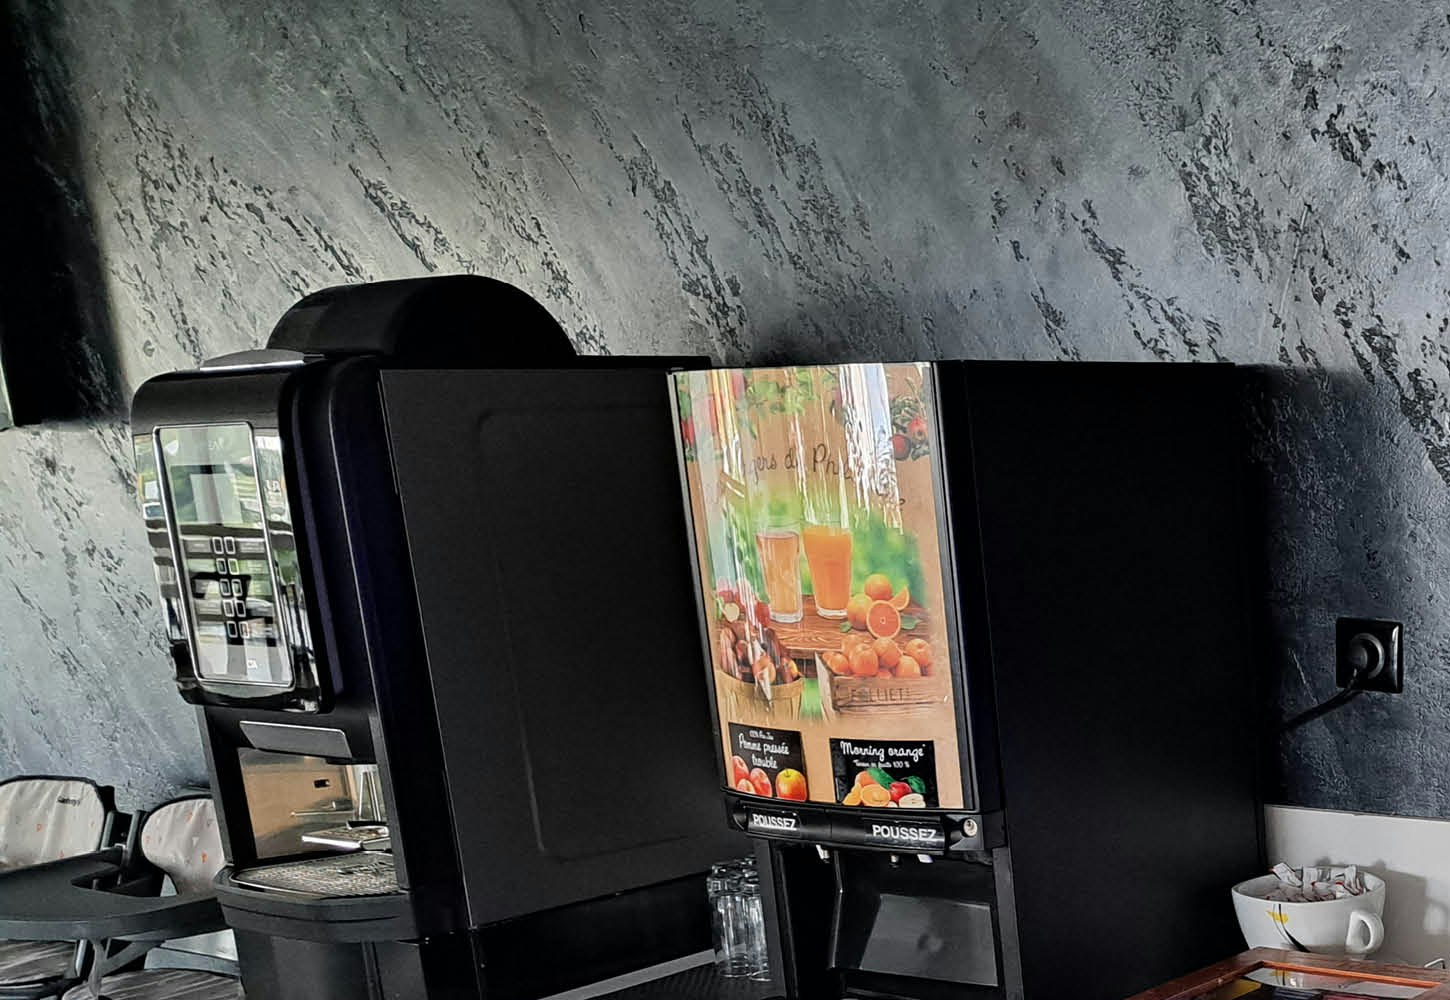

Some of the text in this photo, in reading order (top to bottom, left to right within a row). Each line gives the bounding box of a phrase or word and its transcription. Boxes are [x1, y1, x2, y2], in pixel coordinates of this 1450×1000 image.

[763, 741, 790, 755] pressée
[839, 740, 885, 762] Morning
[751, 753, 778, 770] trouble
[752, 813, 798, 831] POUSSEZ
[872, 825, 937, 842] POUSSEZ
